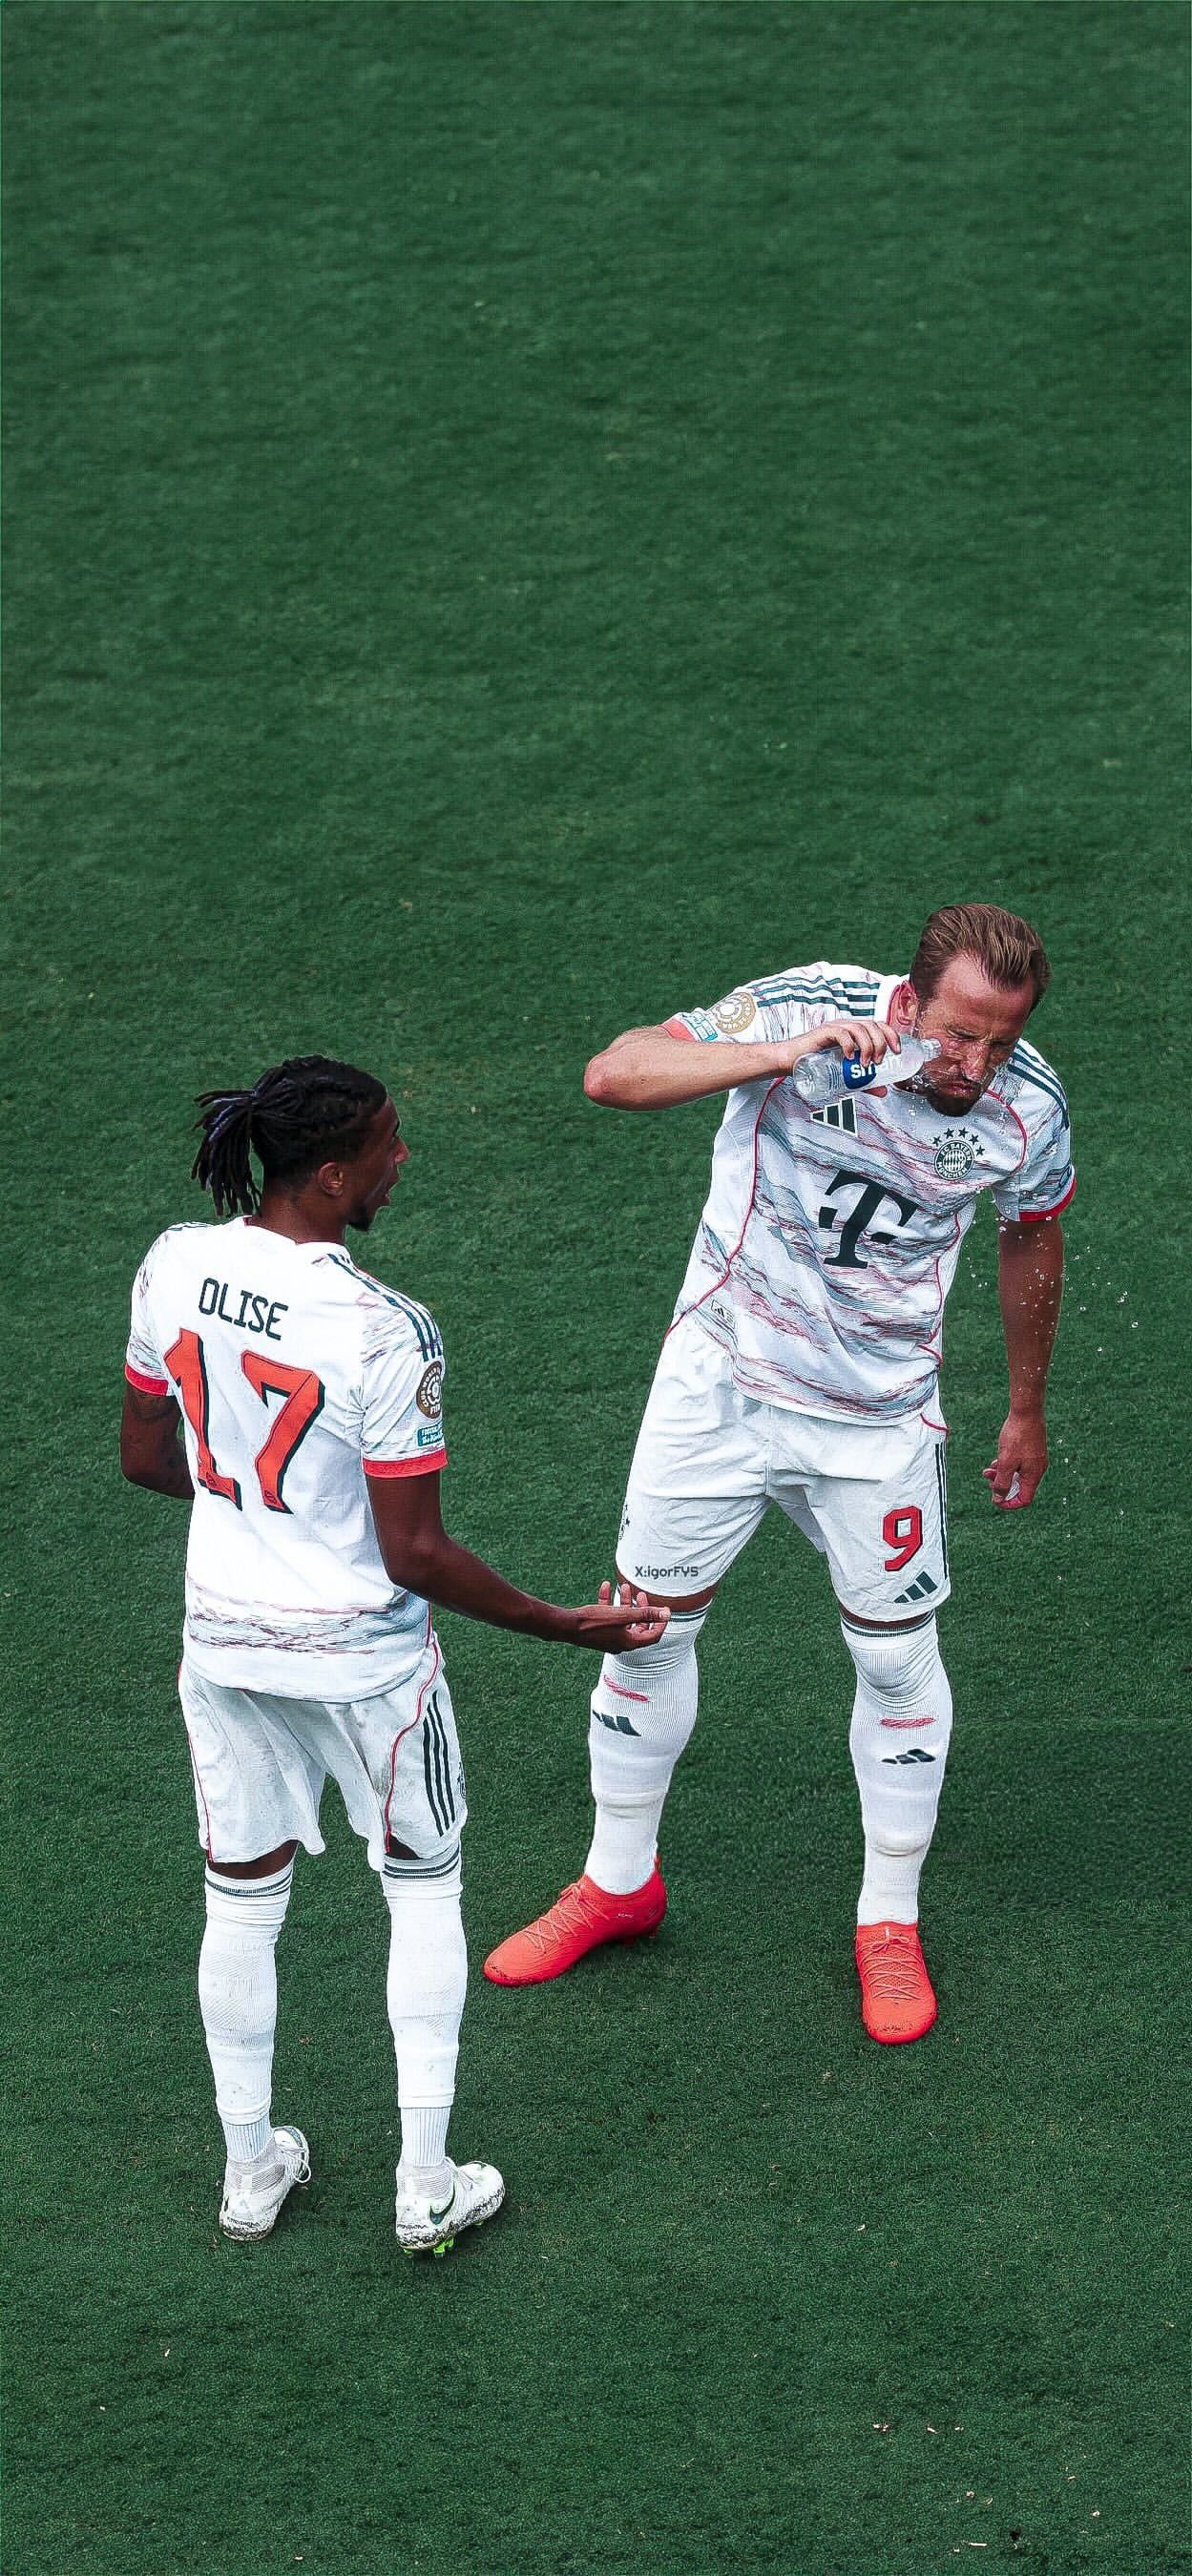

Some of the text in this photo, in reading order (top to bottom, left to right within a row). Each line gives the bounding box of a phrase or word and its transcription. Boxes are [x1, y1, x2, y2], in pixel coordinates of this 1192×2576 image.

[951, 1143, 972, 1161] BAYERN
[819, 1169, 919, 1269] T
[199, 1278, 288, 1340] OLISE
[163, 1327, 325, 1514] 17
[882, 1506, 923, 1571] 9
